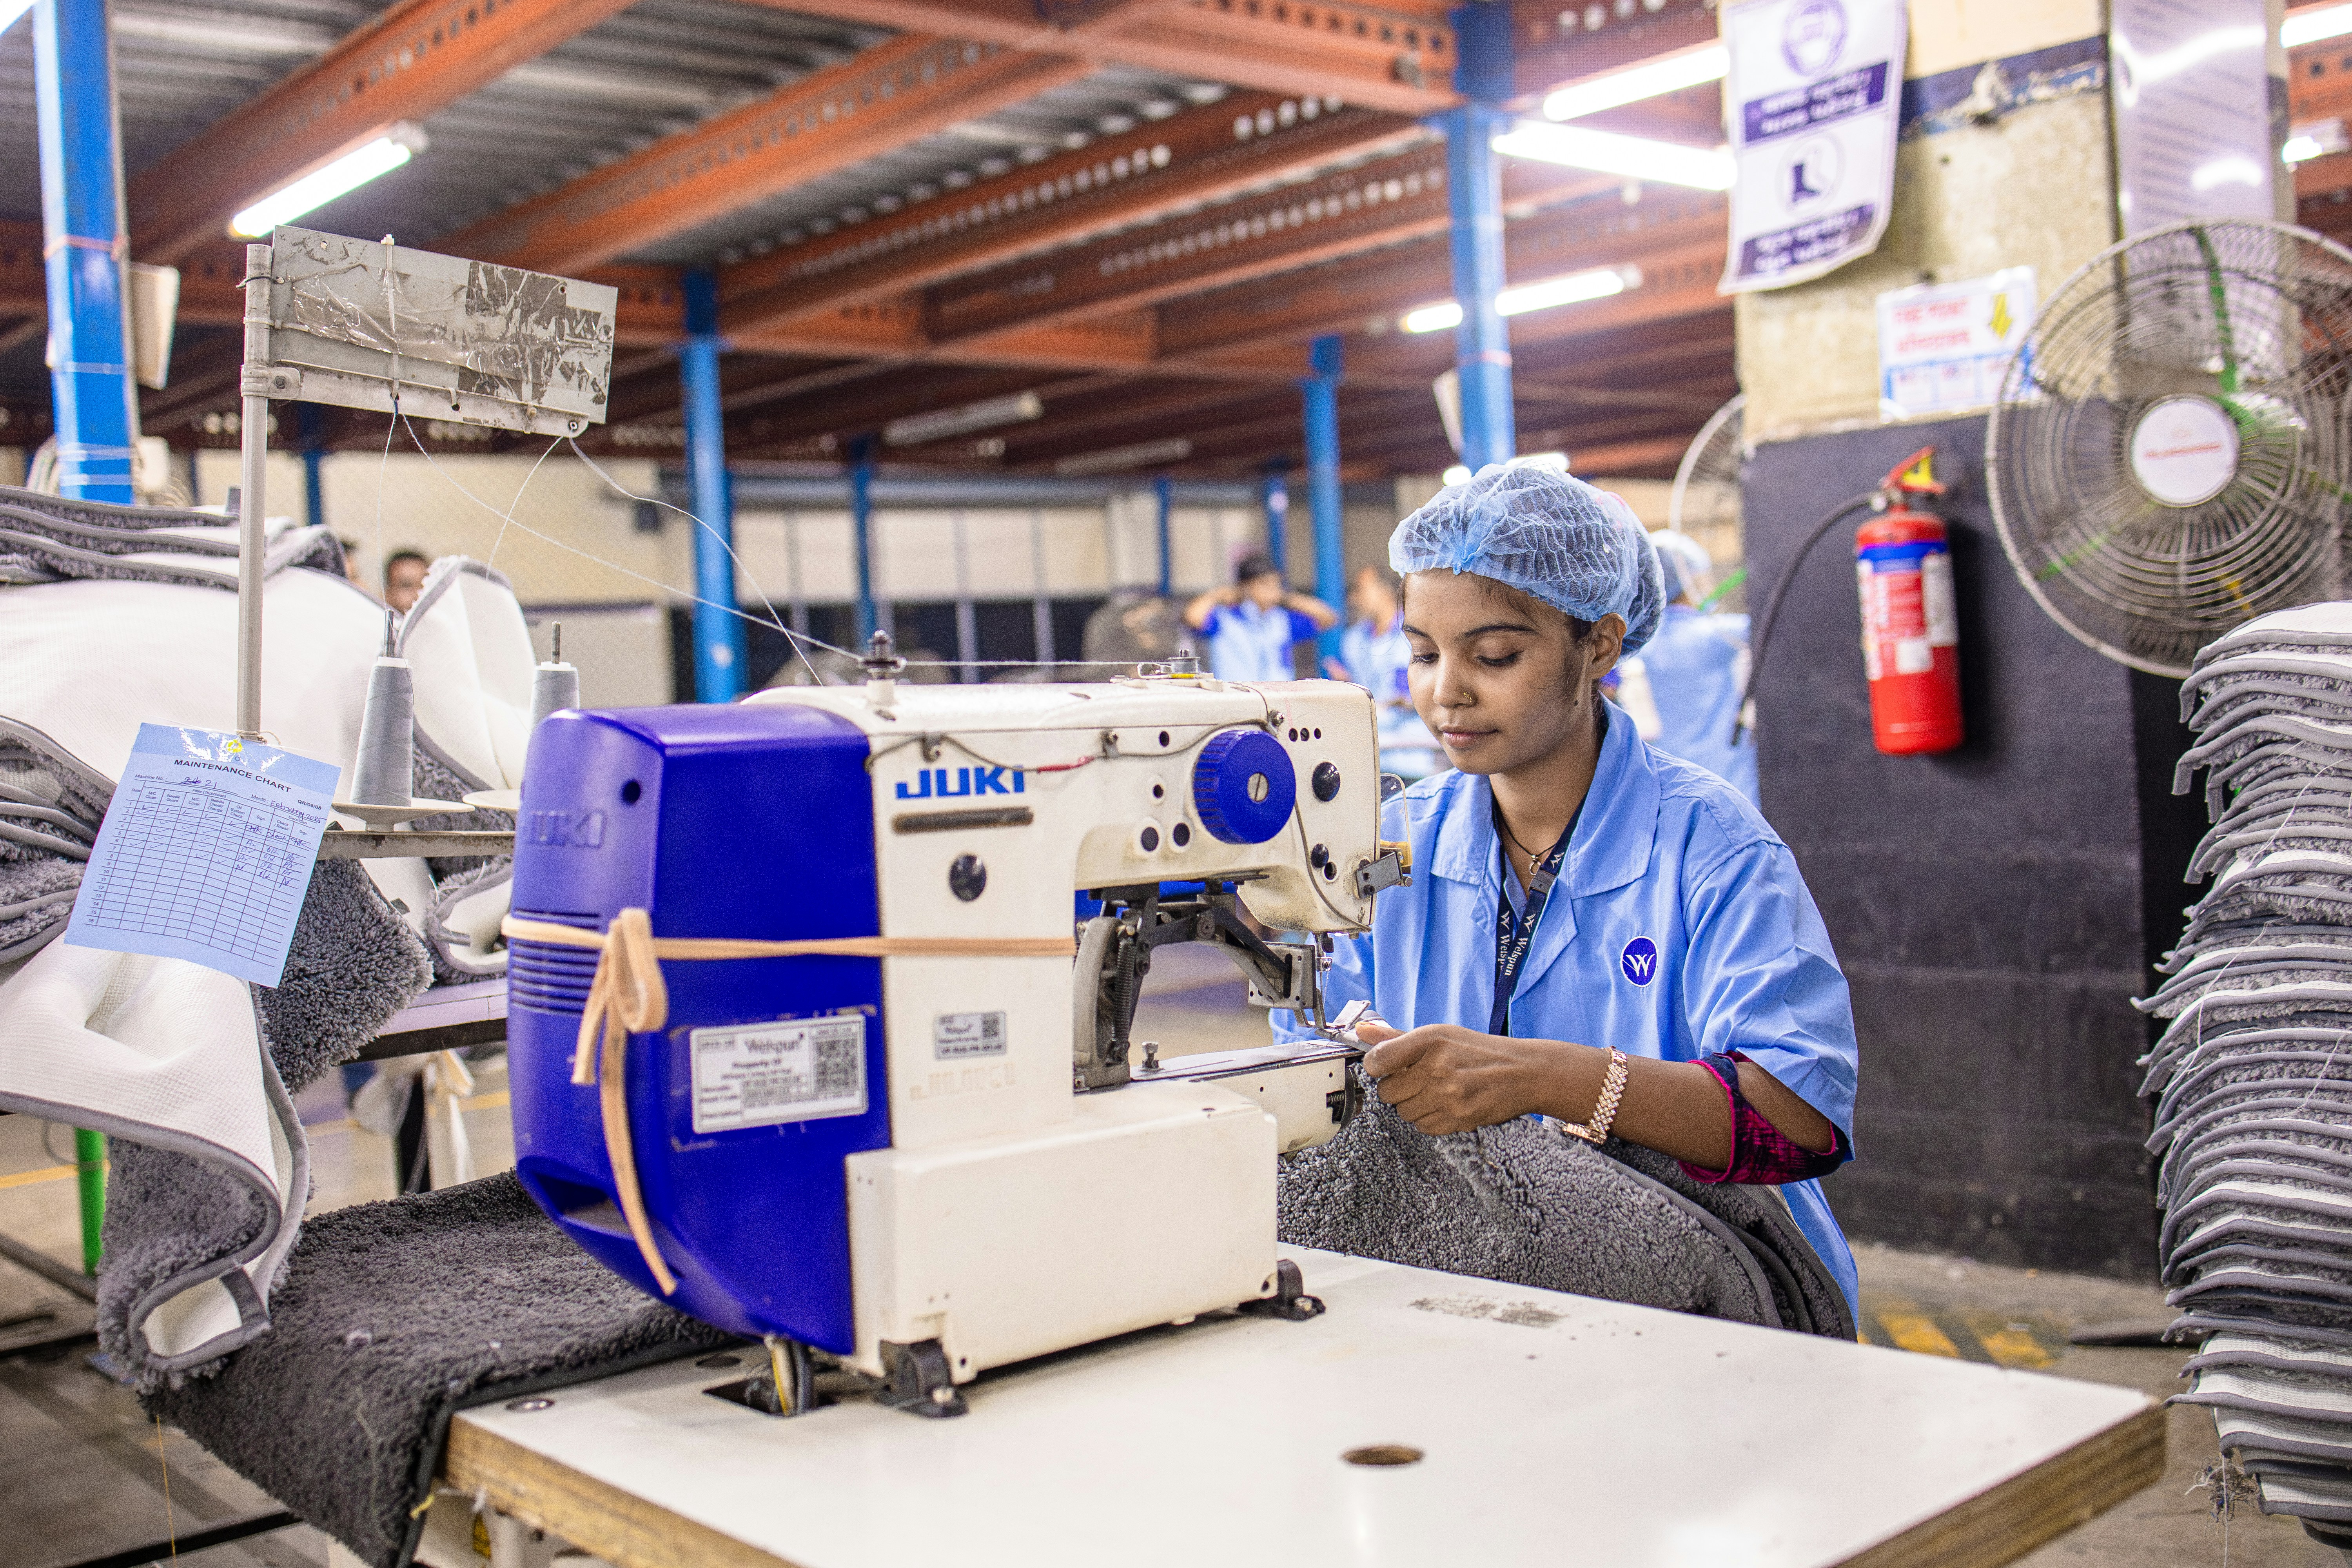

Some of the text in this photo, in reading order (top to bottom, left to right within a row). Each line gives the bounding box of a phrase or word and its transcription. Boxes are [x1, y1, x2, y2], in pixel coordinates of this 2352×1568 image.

[174, 759, 292, 793] MAINTENANCE CHART
[895, 765, 1025, 800] JUKI
[203, 790, 227, 799] (Technician)
[298, 799, 321, 810] QR/08/08
[1497, 935, 1510, 971] Welsp
[1504, 938, 1528, 976] Welspun
[743, 1037, 800, 1054] Welspun
